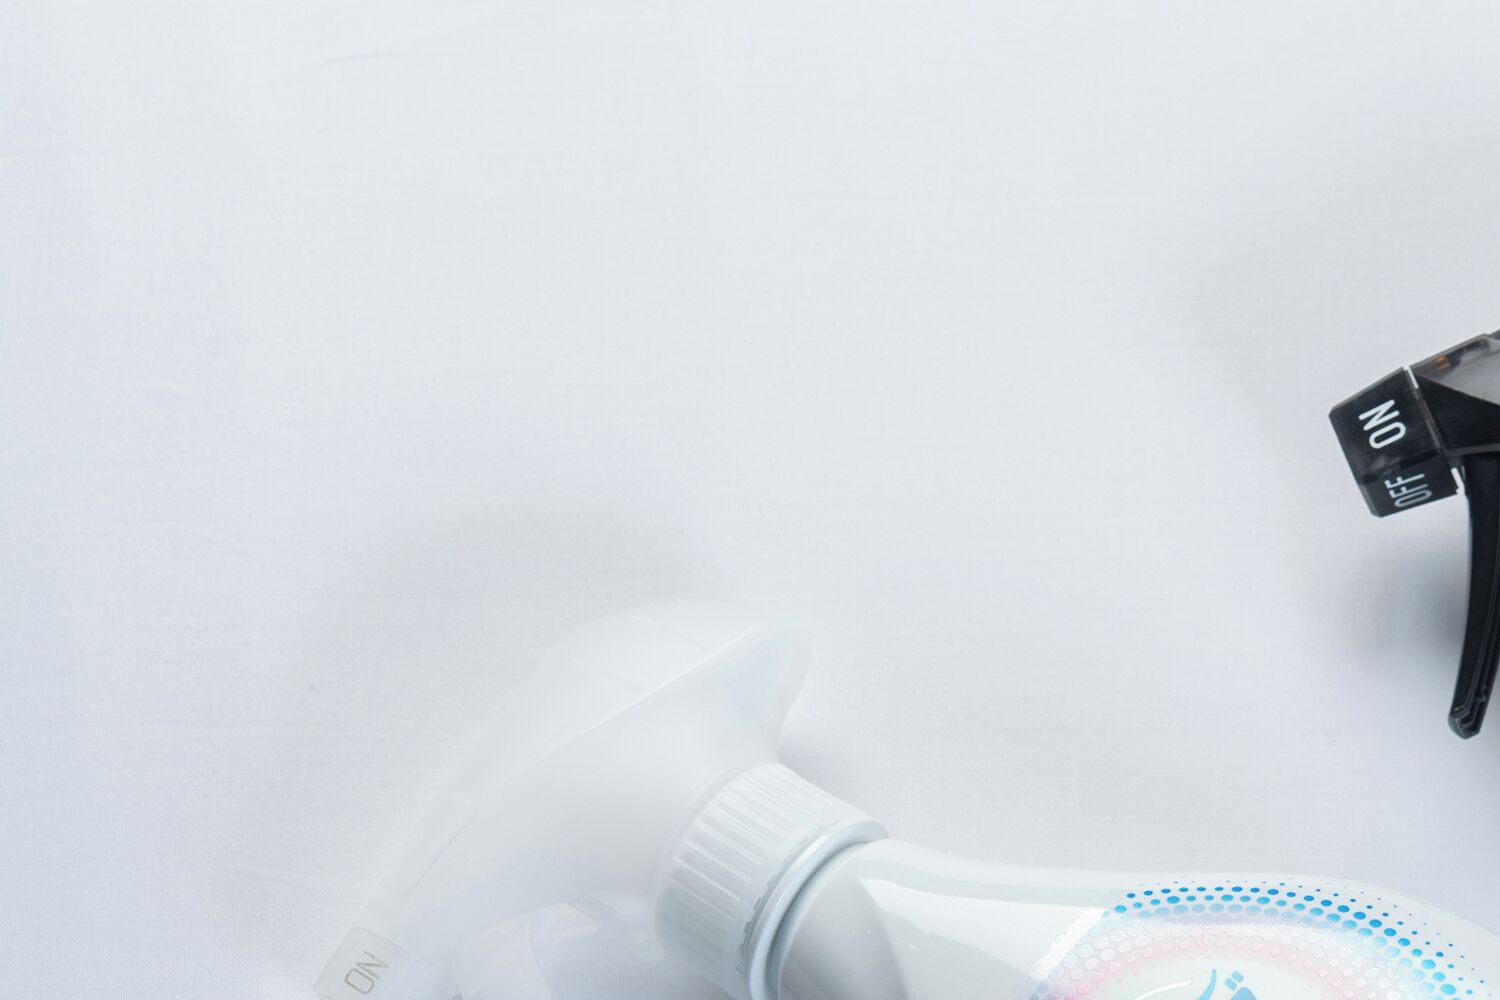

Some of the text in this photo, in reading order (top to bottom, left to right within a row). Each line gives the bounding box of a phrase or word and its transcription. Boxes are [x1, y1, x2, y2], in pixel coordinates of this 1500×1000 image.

[1358, 399, 1407, 450] ON
[1384, 473, 1433, 508] OFF
[344, 950, 389, 995] ON
